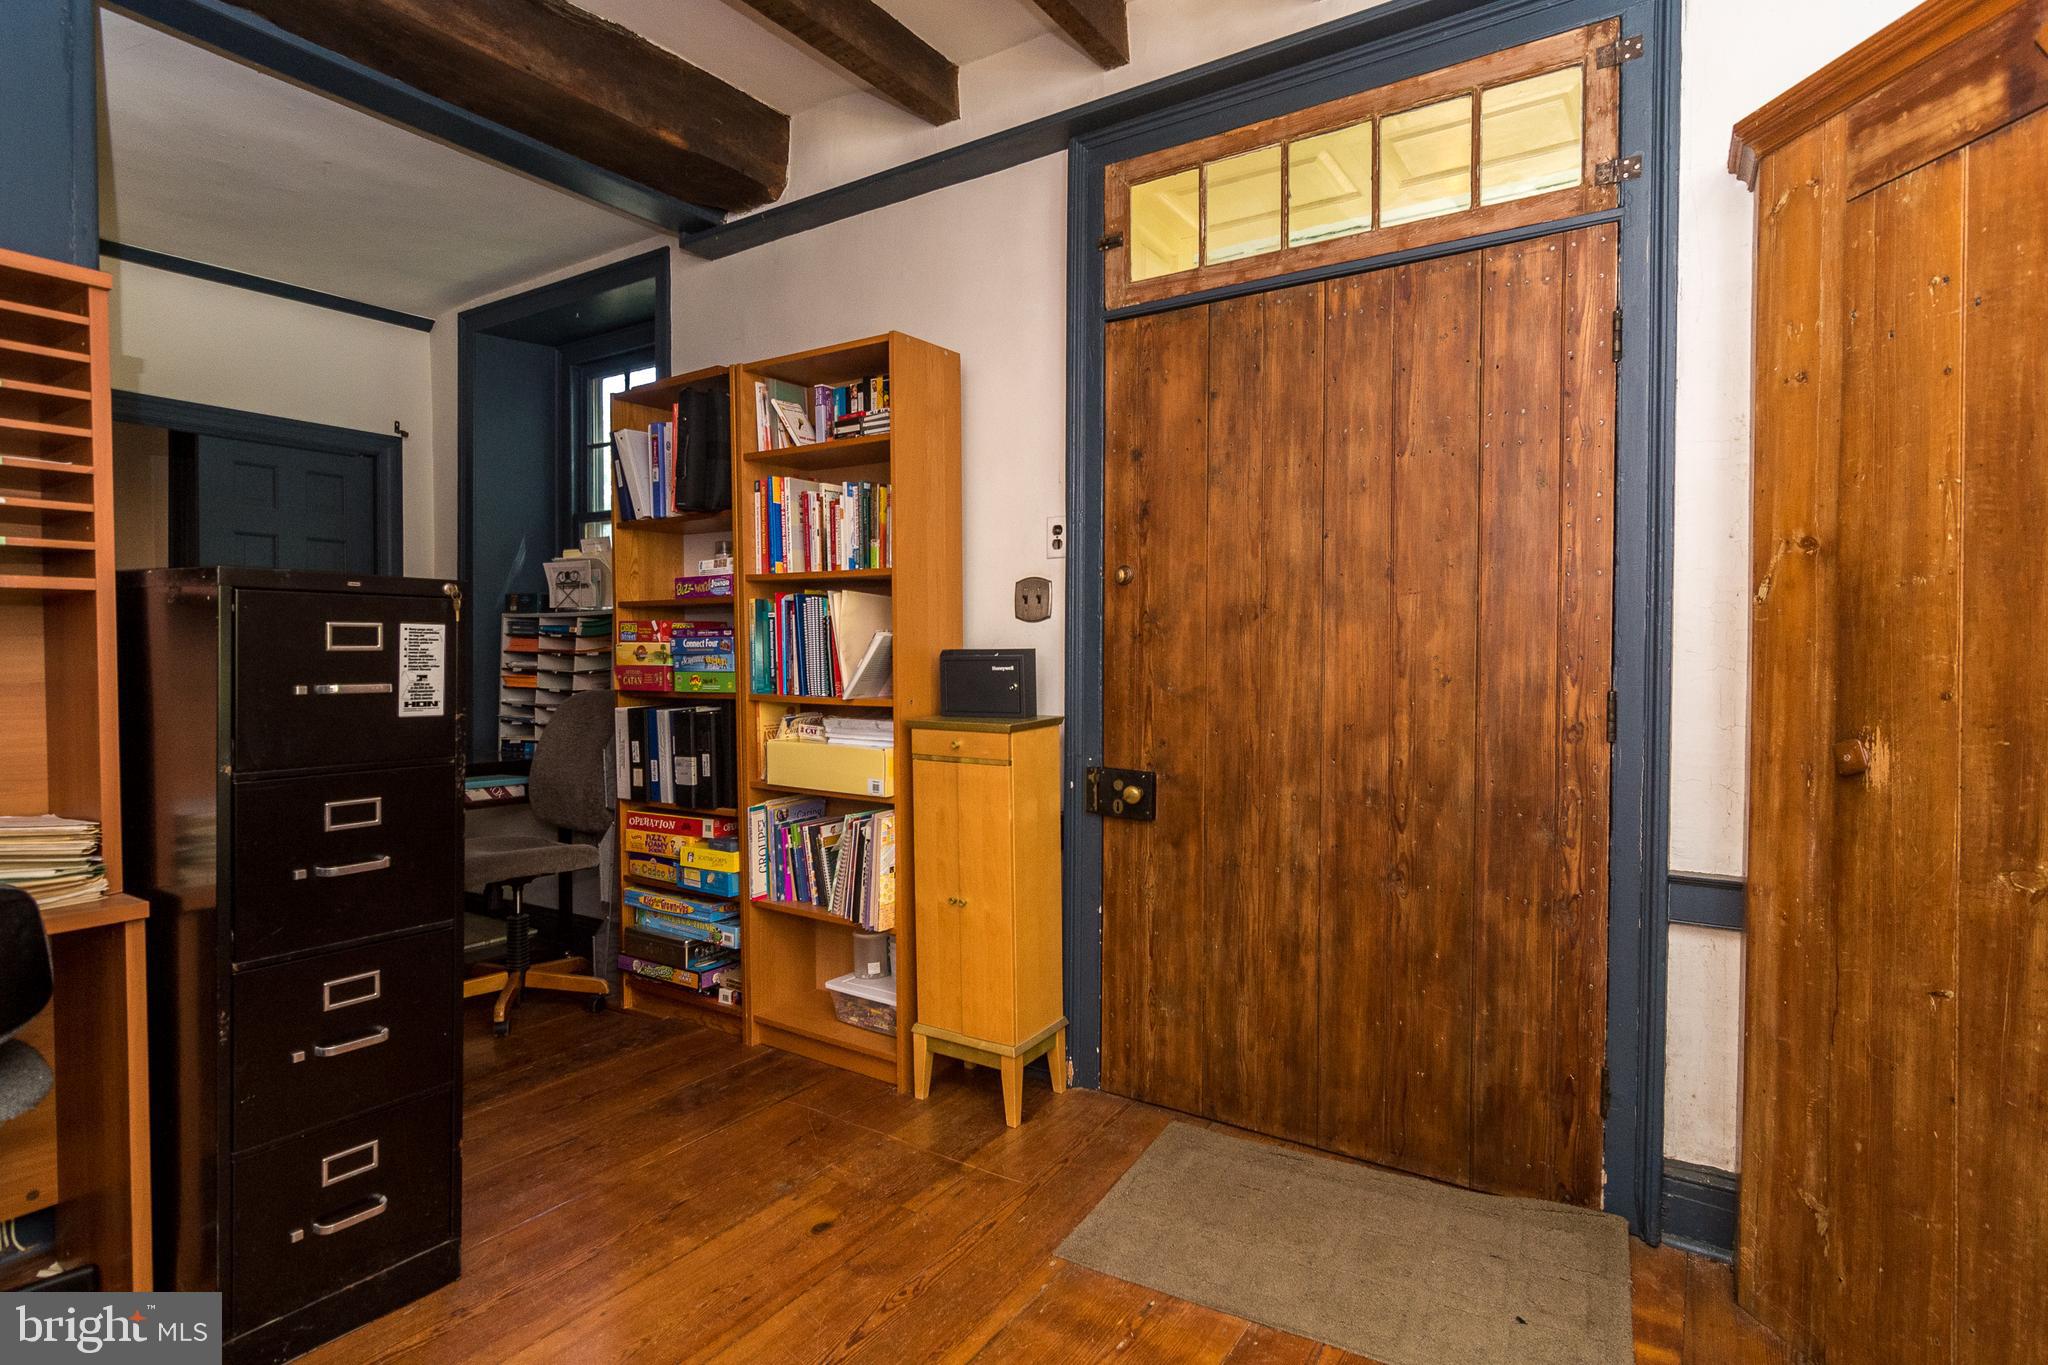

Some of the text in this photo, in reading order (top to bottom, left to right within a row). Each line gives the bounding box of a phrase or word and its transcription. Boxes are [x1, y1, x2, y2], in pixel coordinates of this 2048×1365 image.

[683, 639, 718, 648] Connect Four
[623, 676, 642, 685] CATAN
[628, 817, 676, 830] OPERATION
